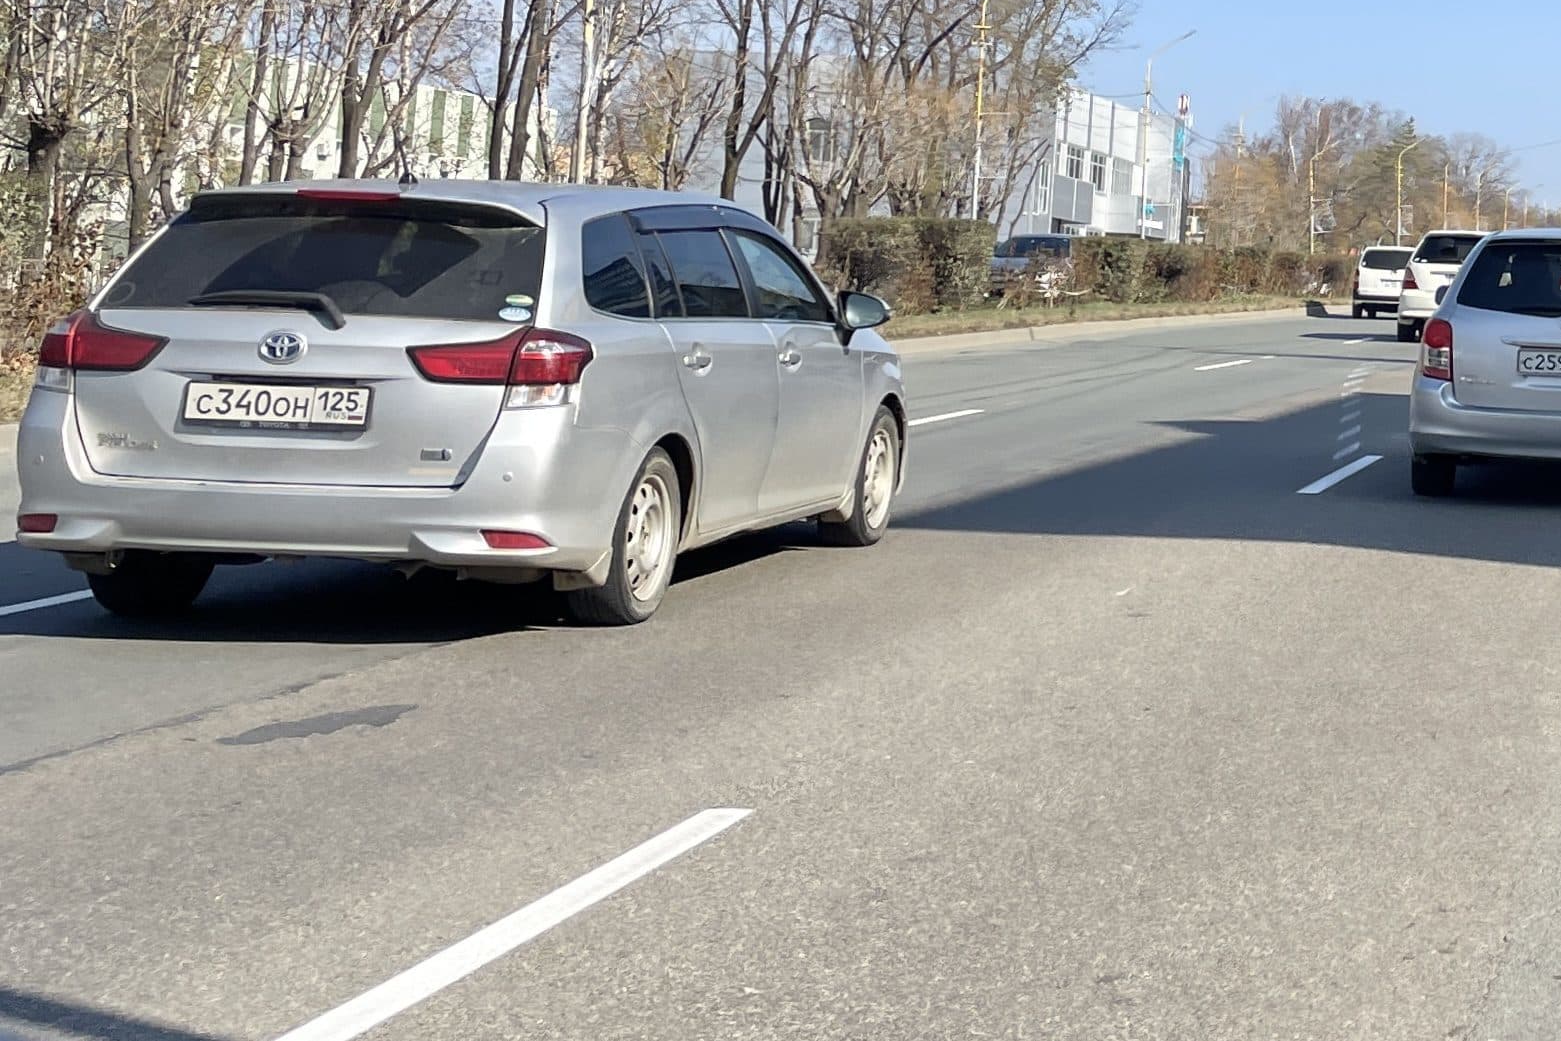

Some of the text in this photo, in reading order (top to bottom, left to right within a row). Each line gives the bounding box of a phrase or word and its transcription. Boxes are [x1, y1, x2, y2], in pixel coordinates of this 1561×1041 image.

[196, 388, 359, 418] С340ОН 125
[325, 412, 347, 421] RUS
